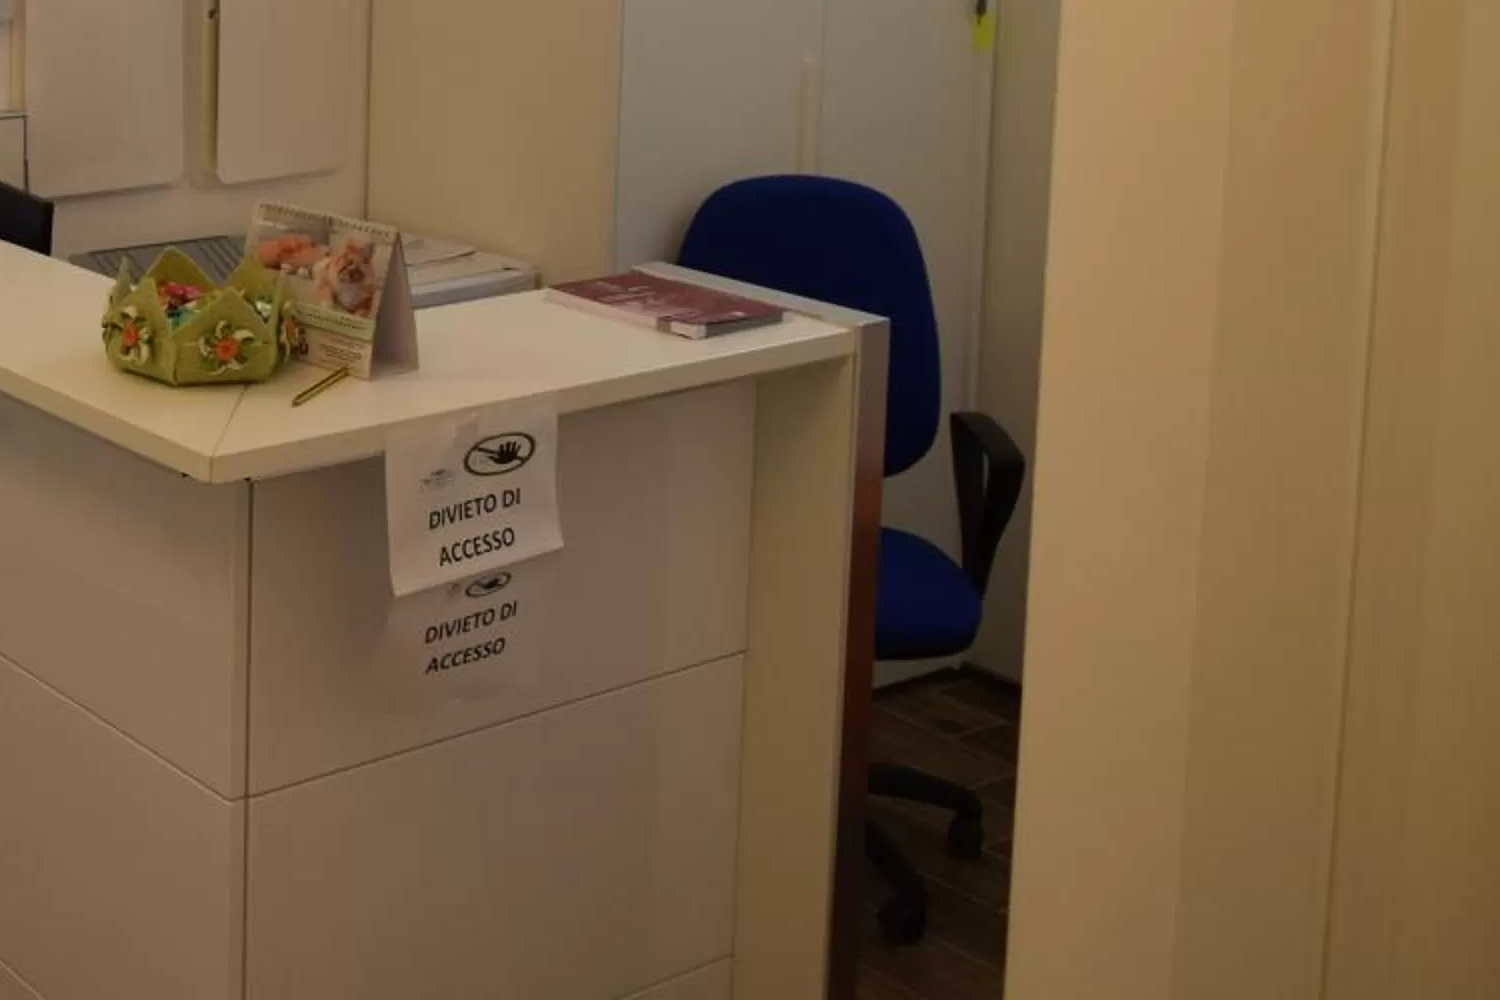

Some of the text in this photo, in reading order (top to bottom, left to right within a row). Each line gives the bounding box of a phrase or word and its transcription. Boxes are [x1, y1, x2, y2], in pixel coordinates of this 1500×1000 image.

[429, 488, 521, 530] DIVIETO DI
[439, 527, 515, 566] ACCESSO
[425, 601, 517, 644] DIVIETO DI
[424, 637, 506, 674] ACCESSO
